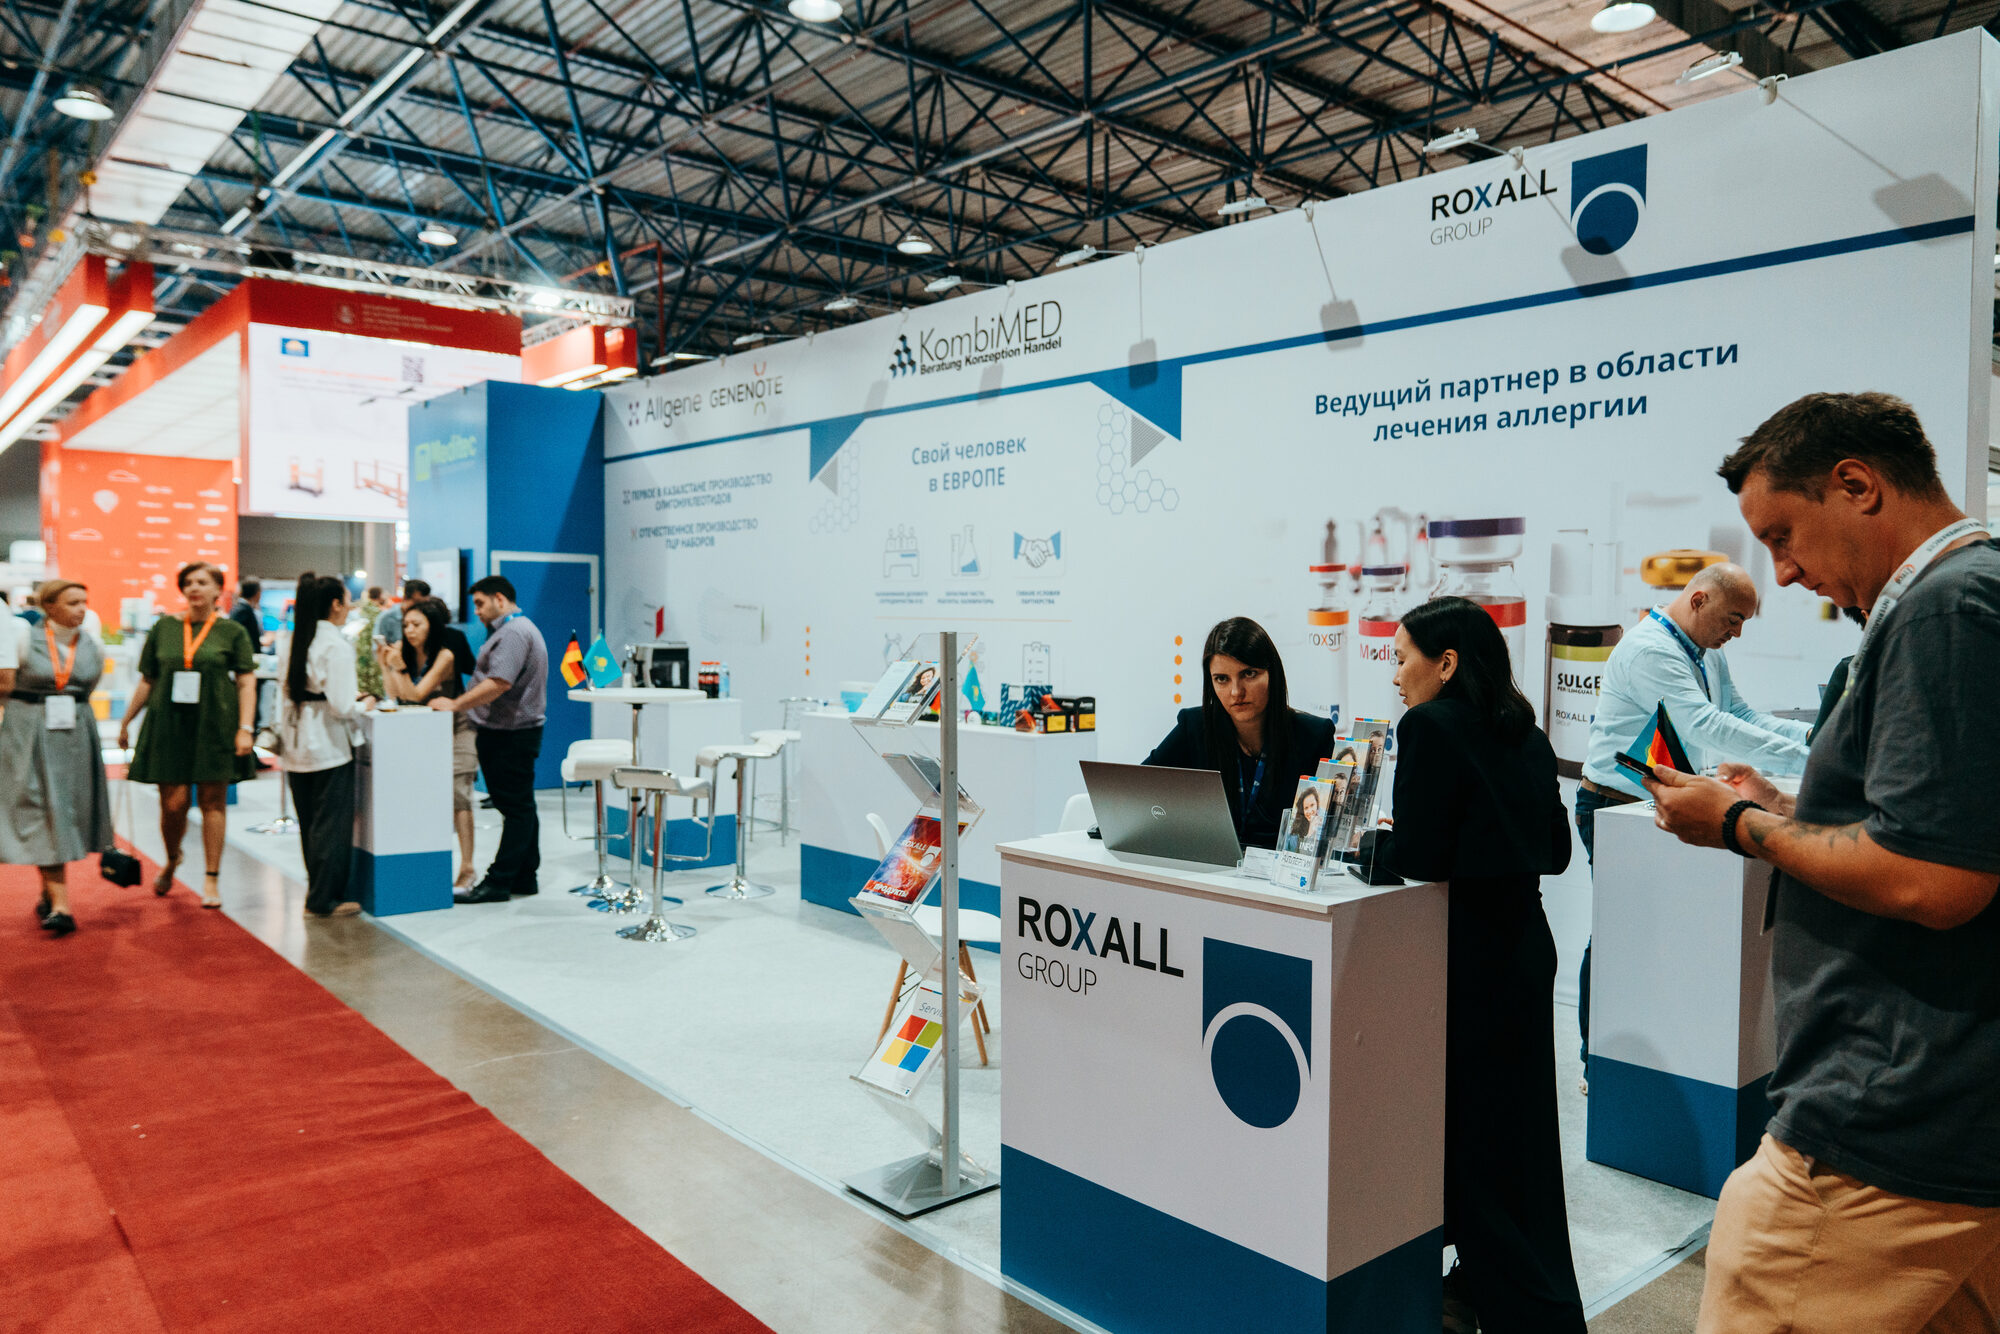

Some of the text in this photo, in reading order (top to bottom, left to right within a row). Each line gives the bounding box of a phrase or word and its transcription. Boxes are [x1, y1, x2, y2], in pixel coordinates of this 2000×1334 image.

[1431, 168, 1557, 221] ROXALL
[1430, 216, 1493, 246] GROUP
[919, 300, 1062, 364] KombiMED
[919, 336, 1062, 376] Beratung Konzeption Handel
[645, 375, 784, 428] Allgene GENENOTE
[1314, 343, 1740, 417] Ведущий партнер в области
[1373, 395, 1648, 442] лечения аллергии
[911, 437, 1027, 465] Свой человек
[929, 466, 1005, 492] в ЕВРОПЕ
[1557, 672, 1602, 689] SULGE
[1555, 709, 1588, 722] ROXALL
[1018, 896, 1184, 978] ROXALL
[1018, 952, 1097, 996] GROUP
